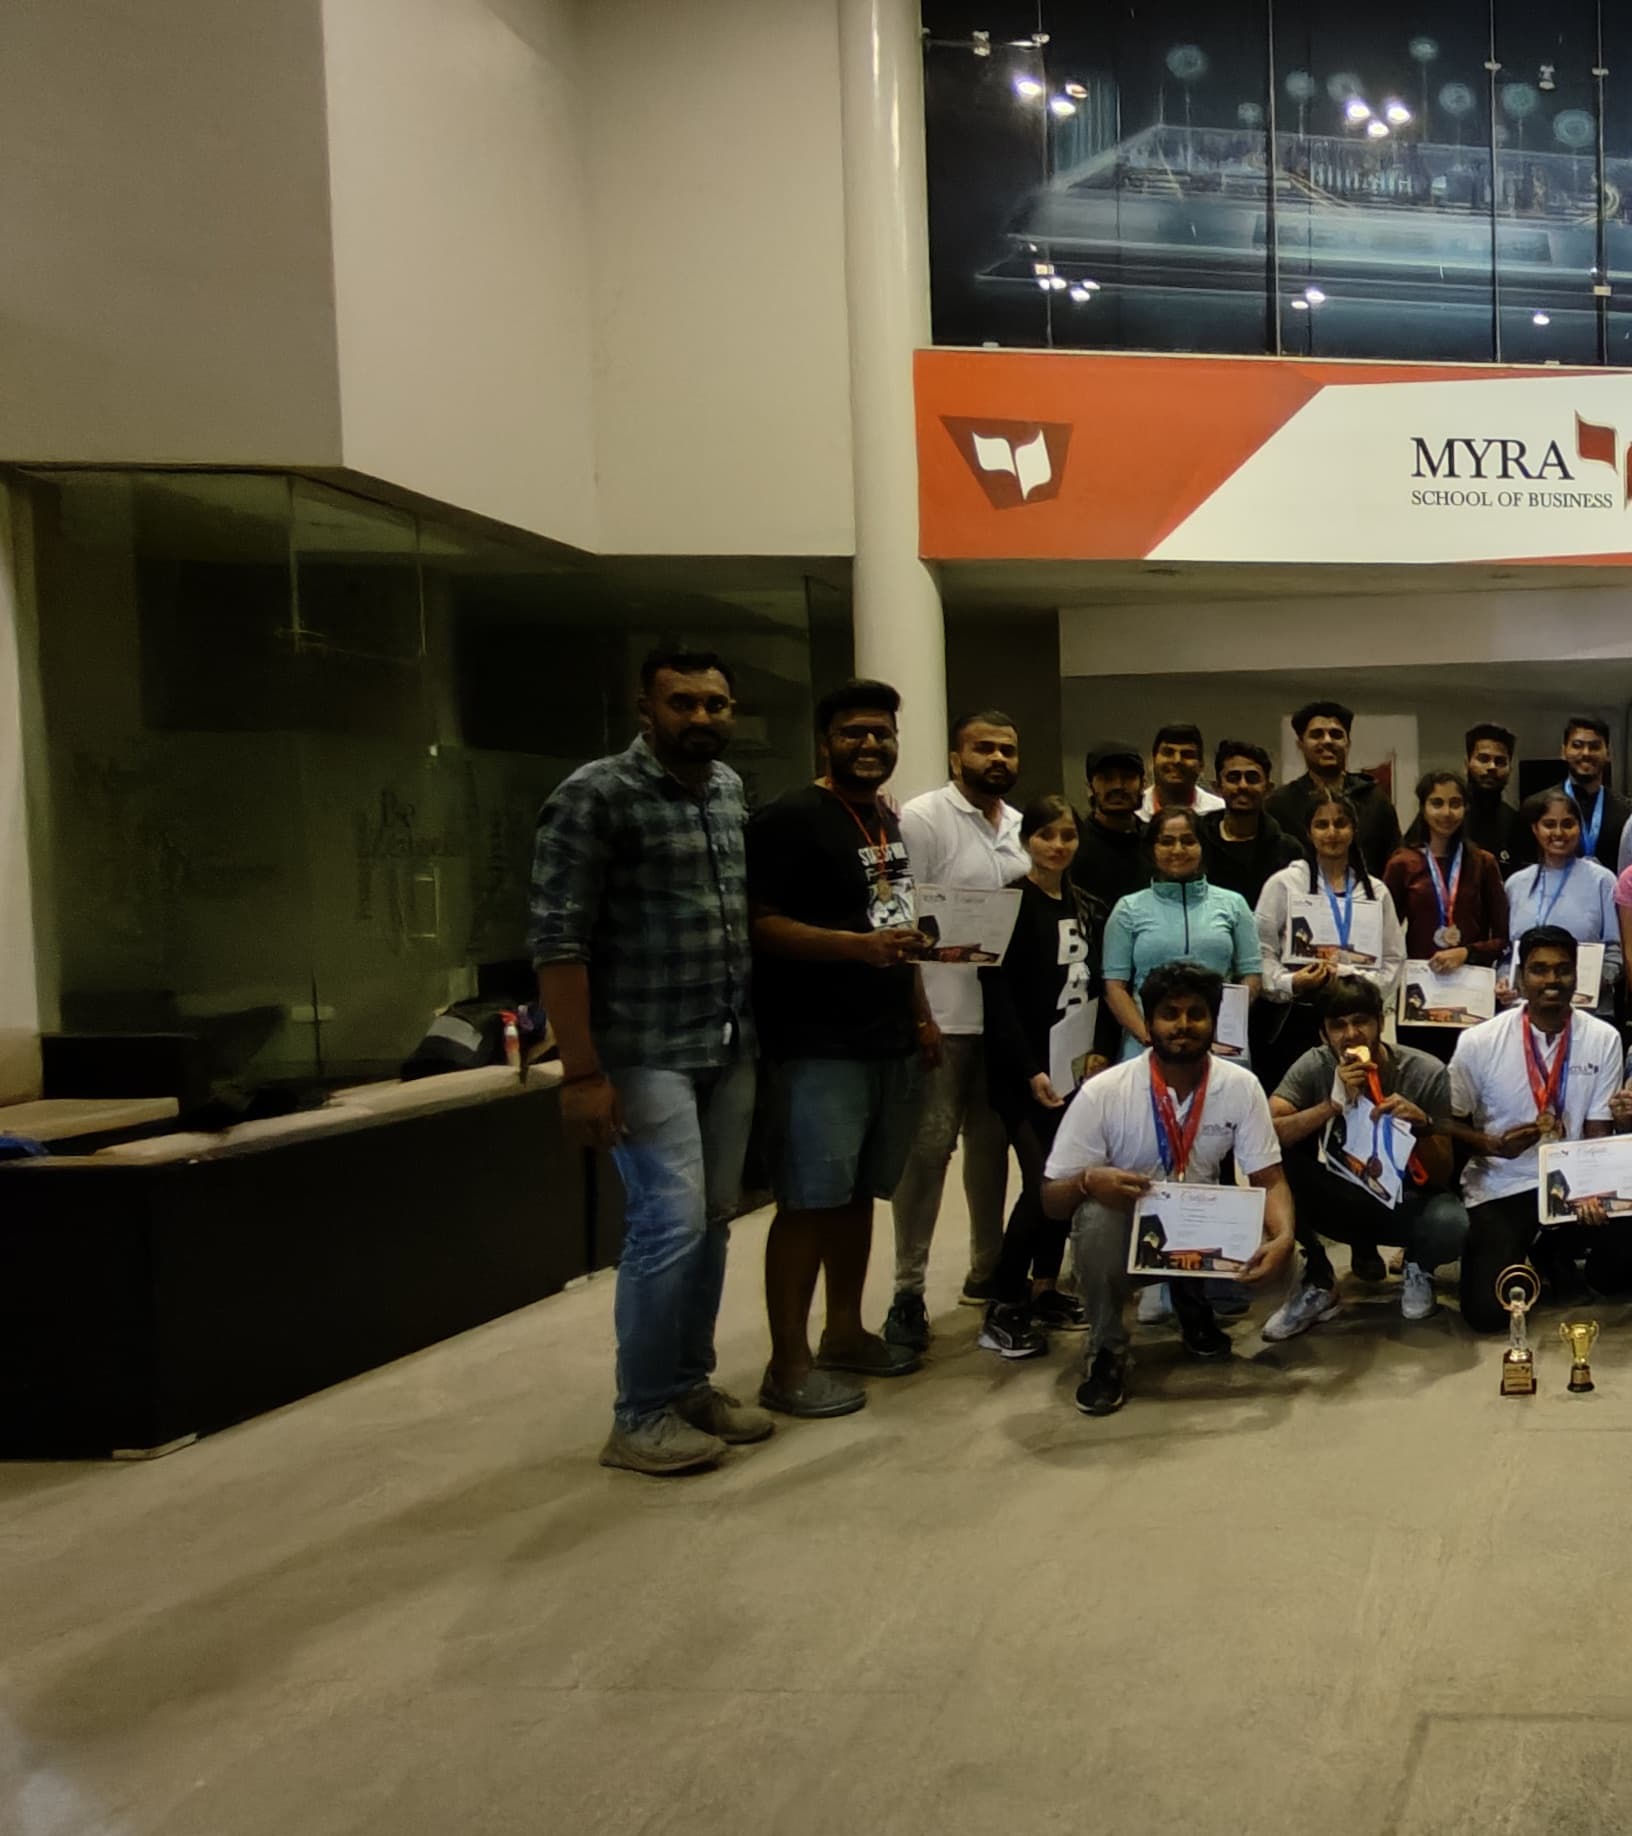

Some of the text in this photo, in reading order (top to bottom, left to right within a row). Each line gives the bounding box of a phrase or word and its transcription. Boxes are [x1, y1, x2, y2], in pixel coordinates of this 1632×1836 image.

[1410, 436, 1575, 480] MYRA
[1410, 489, 1614, 509] SCHOOL OF BUSINESS
